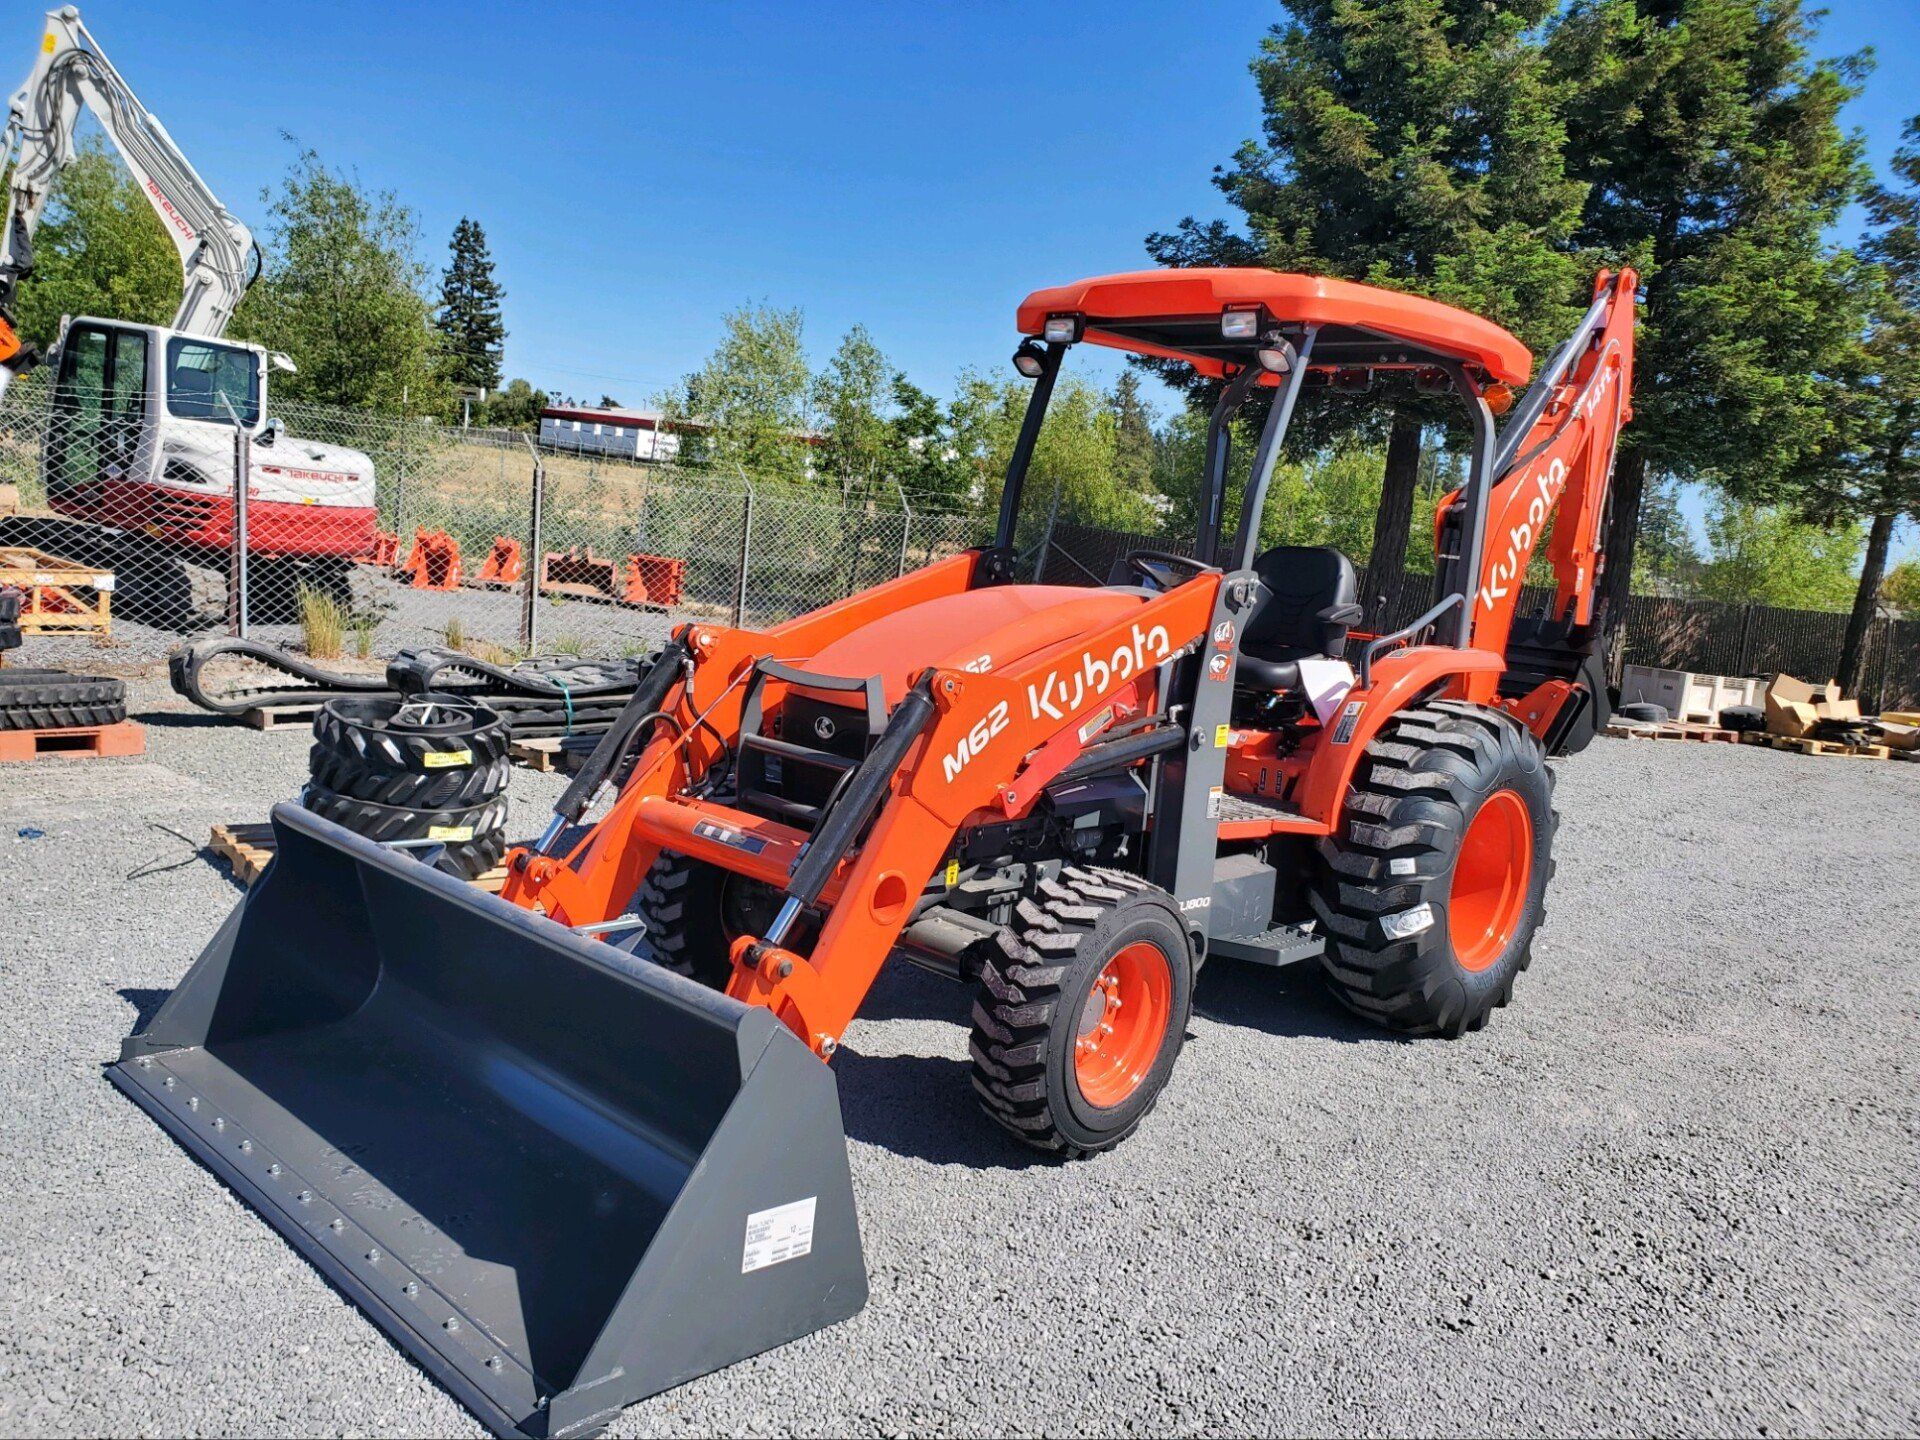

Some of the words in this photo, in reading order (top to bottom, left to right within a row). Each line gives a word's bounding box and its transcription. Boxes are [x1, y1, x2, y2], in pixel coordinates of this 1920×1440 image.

[1481, 456, 1567, 611] Kubota
[1027, 623, 1170, 721] Kubota
[942, 700, 1010, 784] M62
